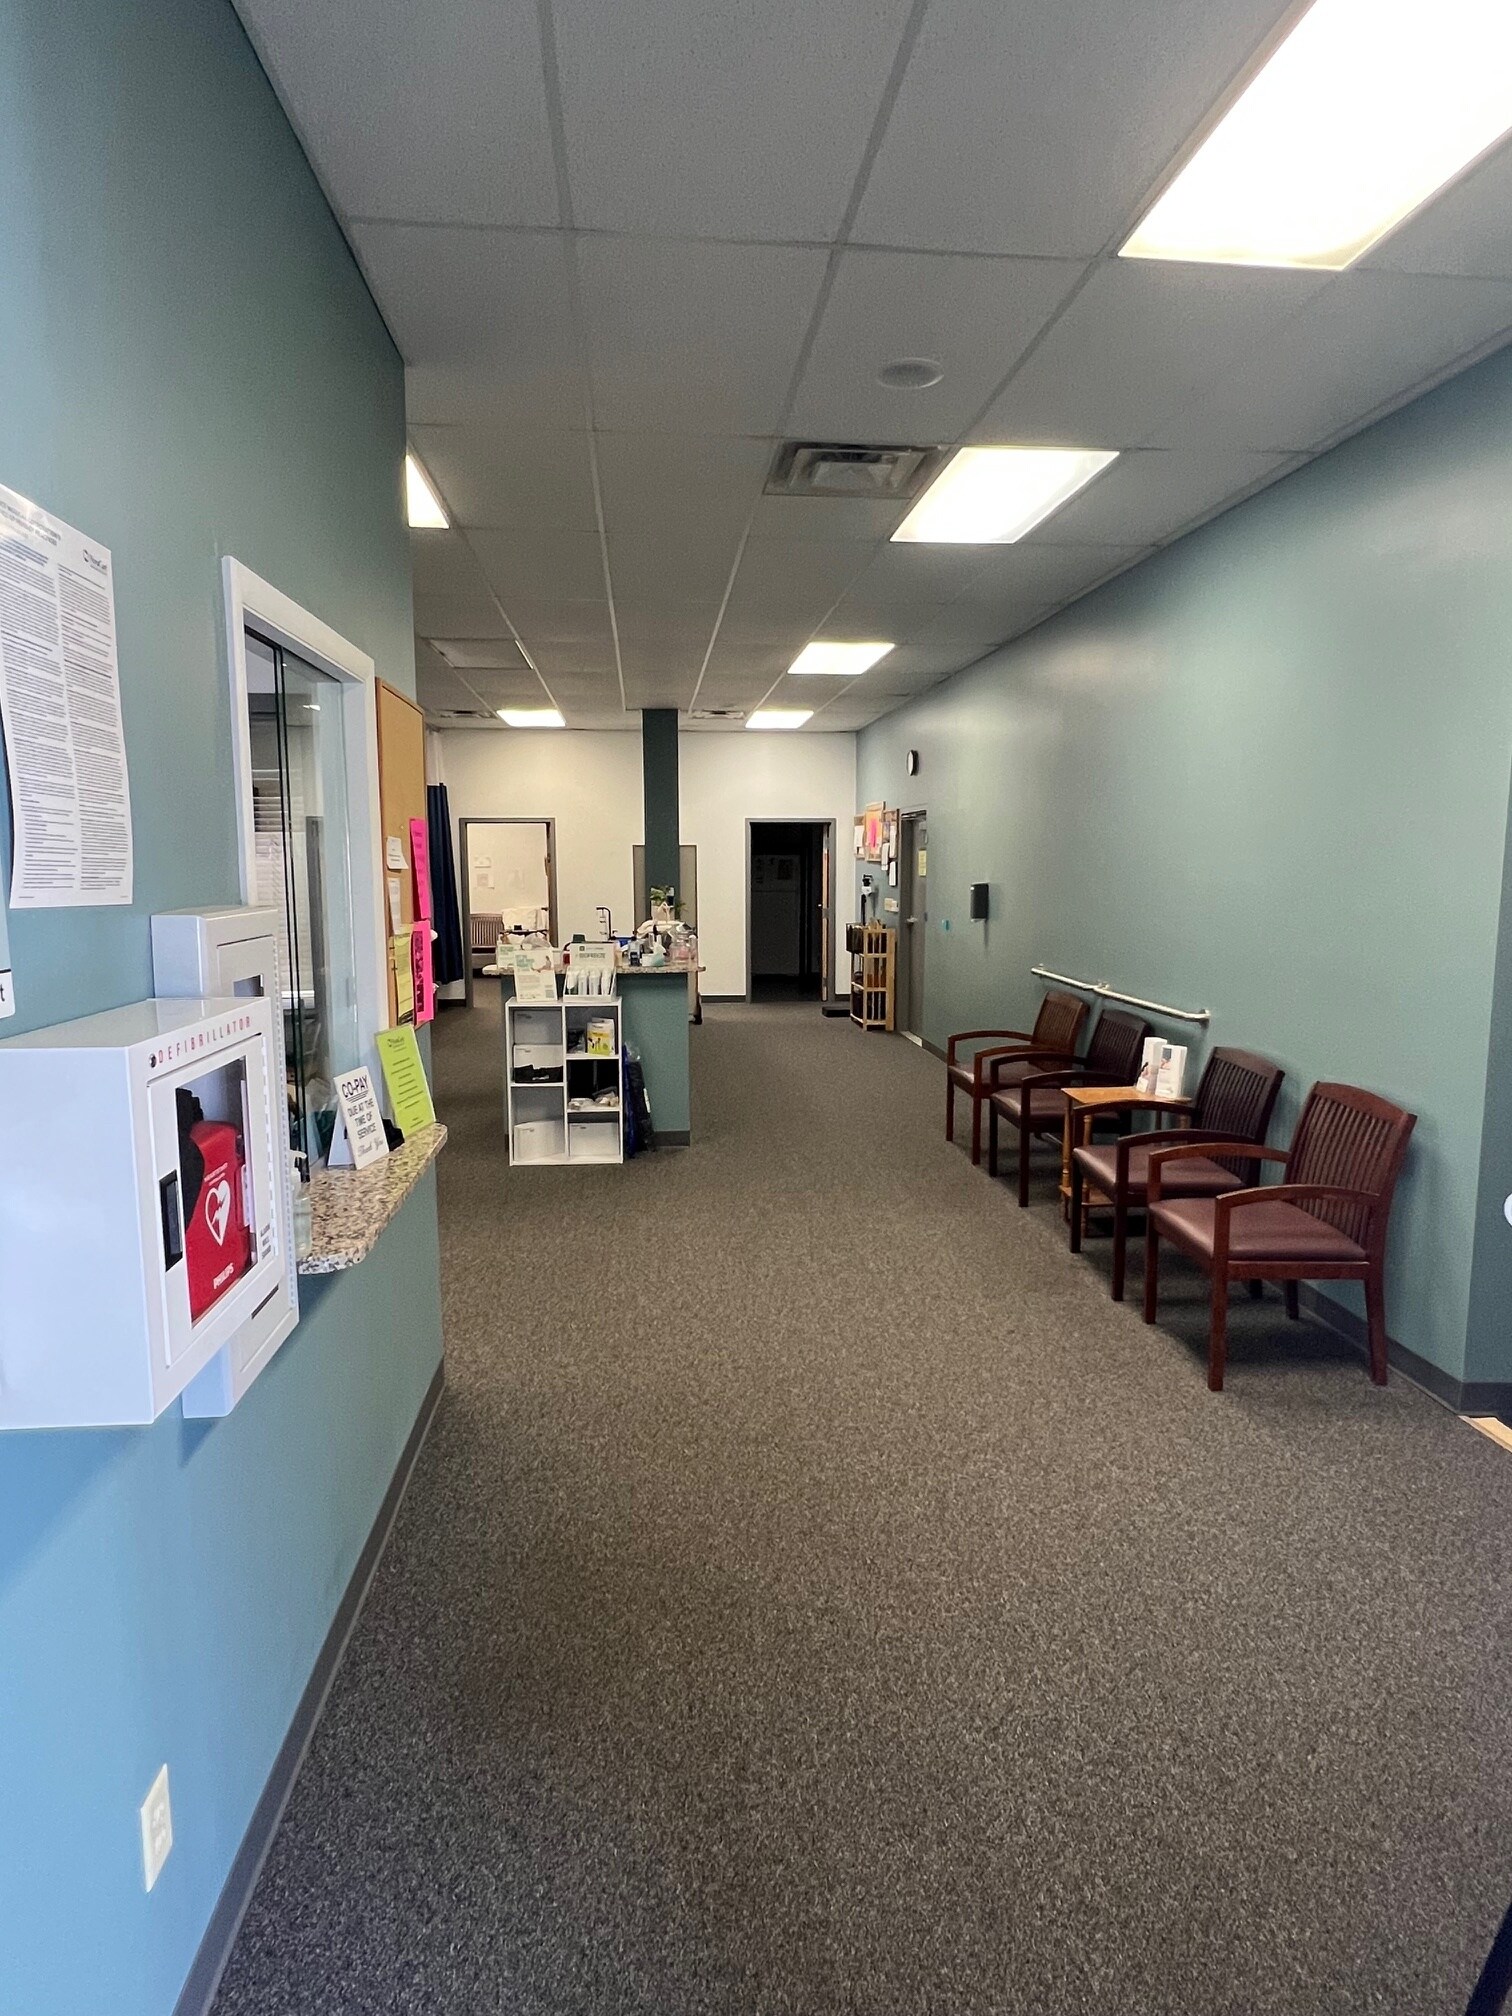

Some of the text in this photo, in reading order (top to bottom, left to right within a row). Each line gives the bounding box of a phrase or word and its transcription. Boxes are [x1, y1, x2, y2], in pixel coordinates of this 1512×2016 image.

[158, 1016, 251, 1063] DEFIBRILLATOR
[342, 1075, 368, 1098] CO-PAY
[347, 1105, 359, 1117] DUE
[365, 1098, 374, 1110] THE
[357, 1122, 376, 1139] SERVICE
[213, 1262, 234, 1289] PHILIPS
